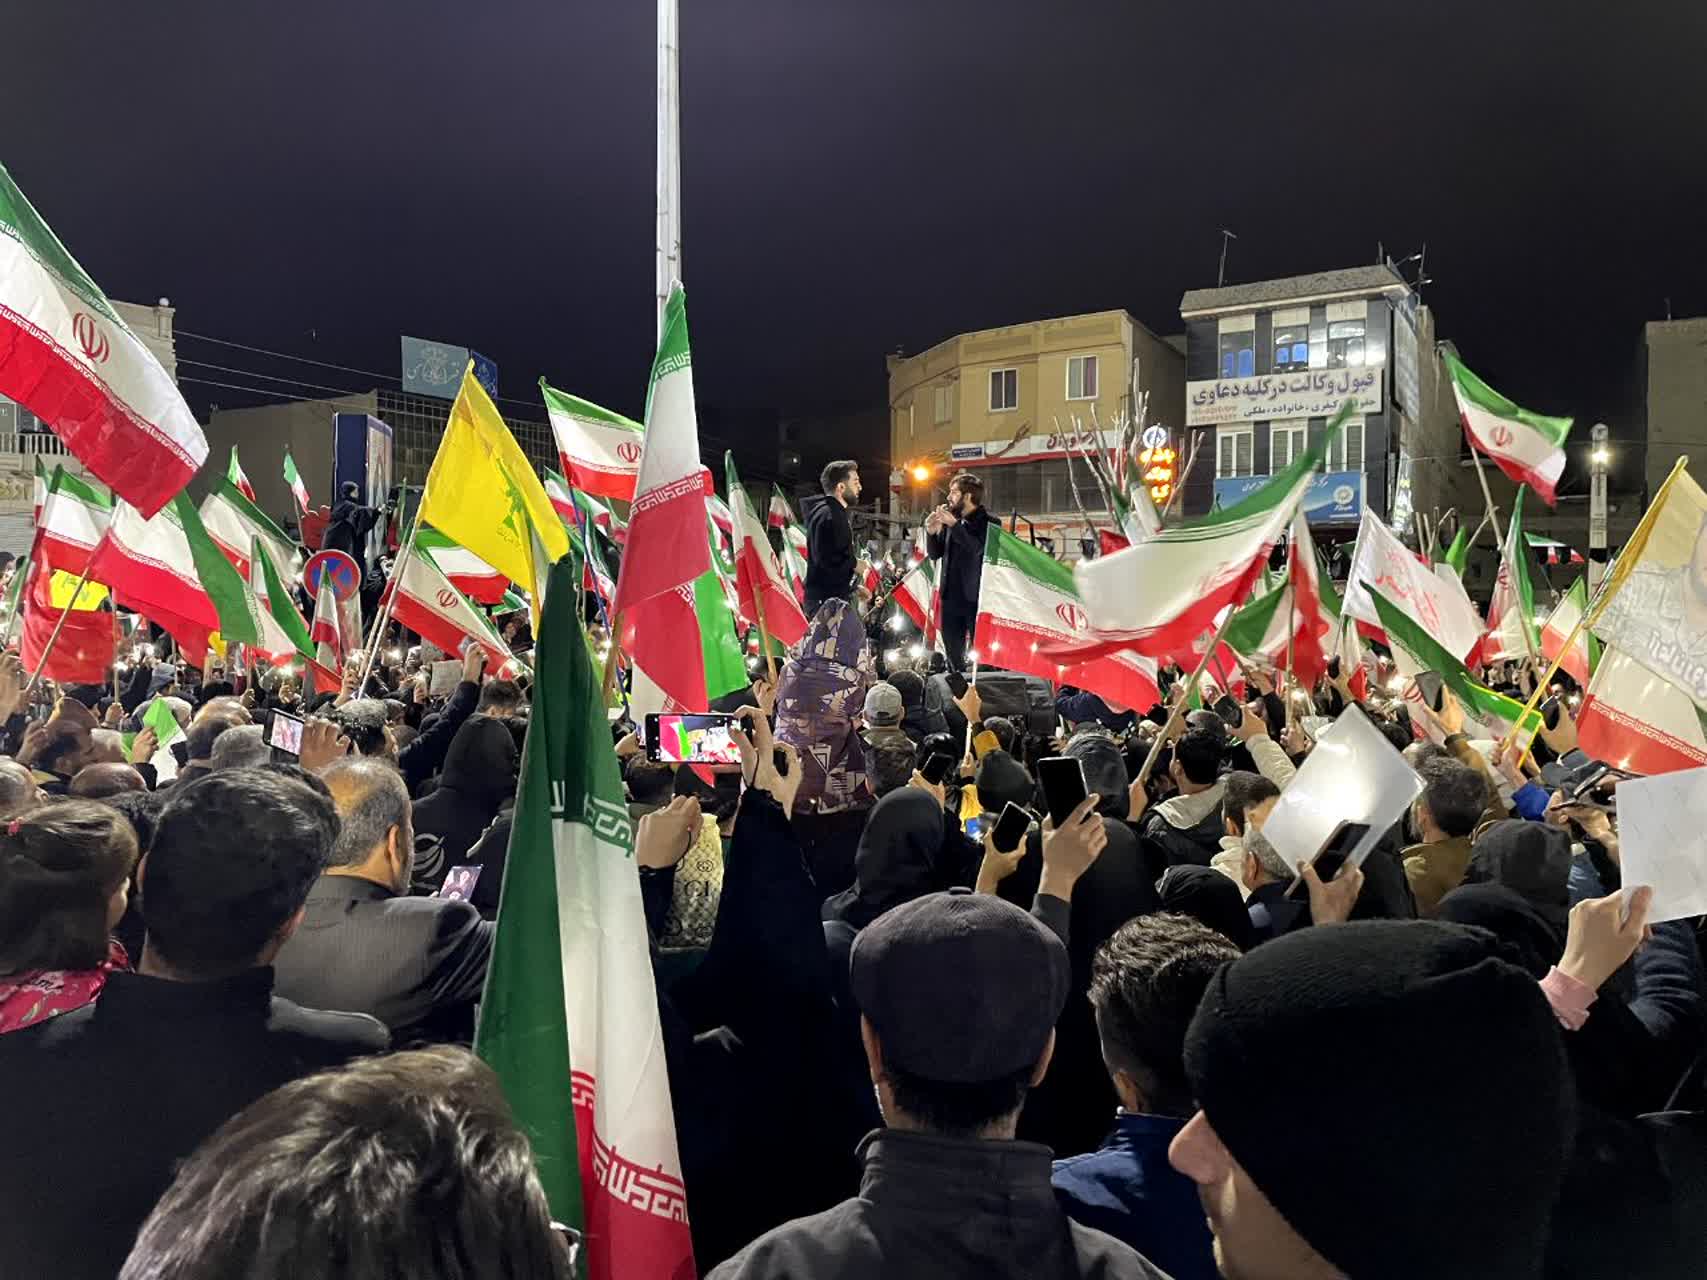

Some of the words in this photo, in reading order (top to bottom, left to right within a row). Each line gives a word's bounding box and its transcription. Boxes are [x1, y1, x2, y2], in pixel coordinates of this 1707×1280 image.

[1242, 379, 1273, 401] کلیه
[1268, 381, 1287, 400] در
[1290, 374, 1334, 395] وکالت
[1337, 370, 1375, 393] قبول
[1192, 383, 1240, 406] دعاوی
